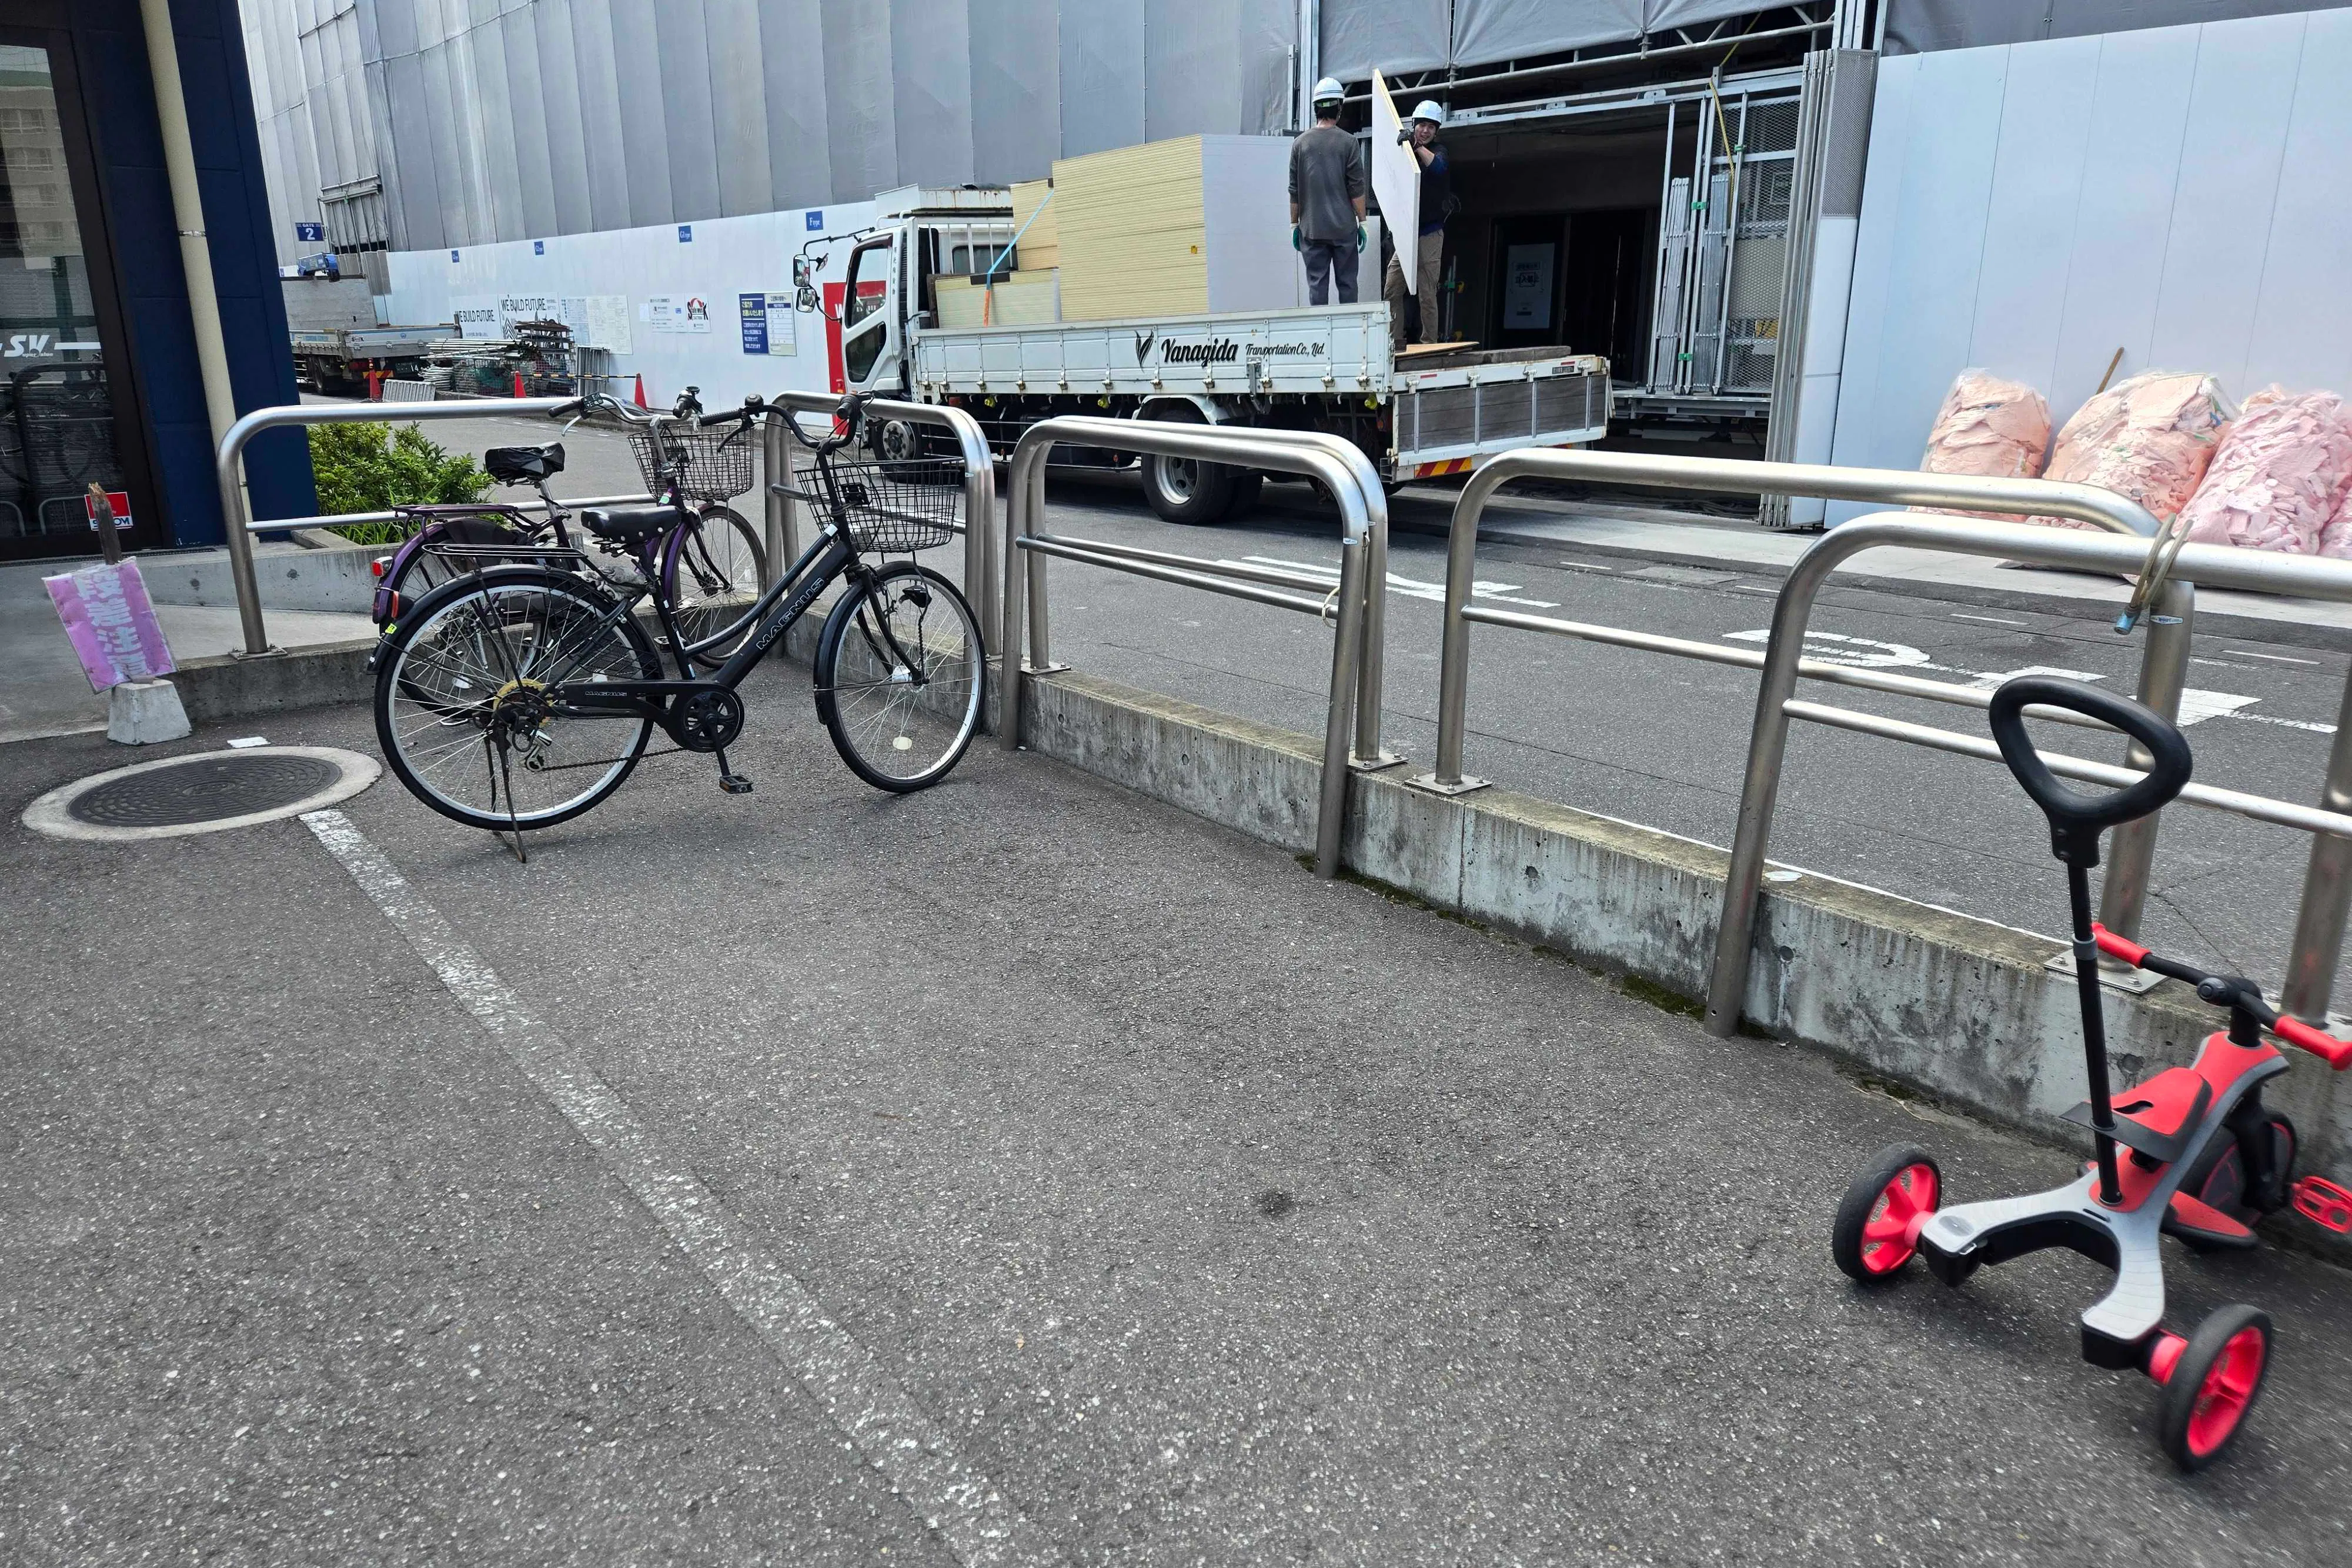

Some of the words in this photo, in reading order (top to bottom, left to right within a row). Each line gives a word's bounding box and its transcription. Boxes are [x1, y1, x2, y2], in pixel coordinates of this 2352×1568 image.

[306, 228, 315, 240] 2
[501, 299, 509, 312] WE
[510, 299, 524, 312] BUILD
[463, 311, 476, 323] BUILD
[1161, 338, 1238, 368] Yanagida
[1245, 343, 1295, 358] Transportation
[1311, 342, 1324, 357] Ltd.
[92, 517, 129, 528] SOM
[756, 578, 824, 650] MAGNUS
